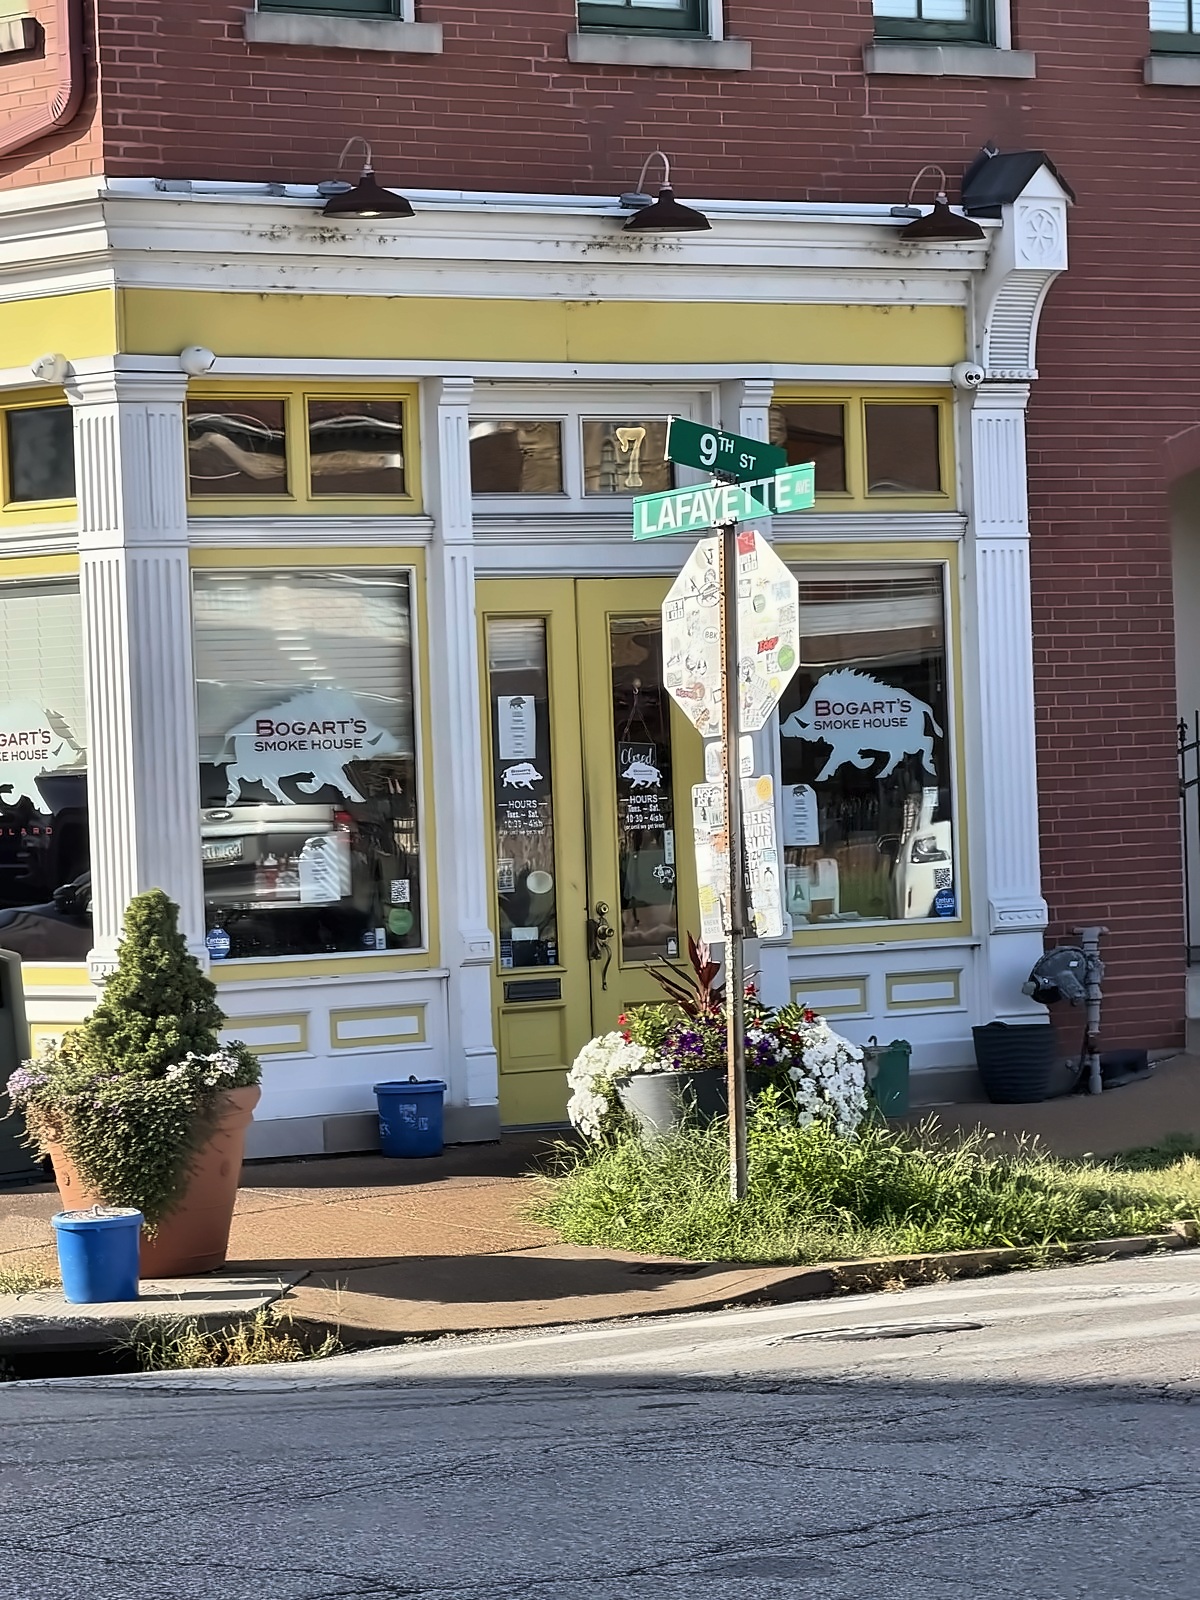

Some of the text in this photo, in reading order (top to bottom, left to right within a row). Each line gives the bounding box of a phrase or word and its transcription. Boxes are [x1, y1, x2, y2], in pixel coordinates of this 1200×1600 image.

[700, 433, 757, 471] 9TH ST
[641, 473, 811, 533] LAFAYETTE AVE
[814, 717, 908, 730] SMOKE HOUSE
[254, 738, 363, 751] SMOKE HOUSE
[11, 749, 48, 760] HOUSE
[508, 800, 538, 809] HOURS
[630, 795, 658, 804] HOURS
